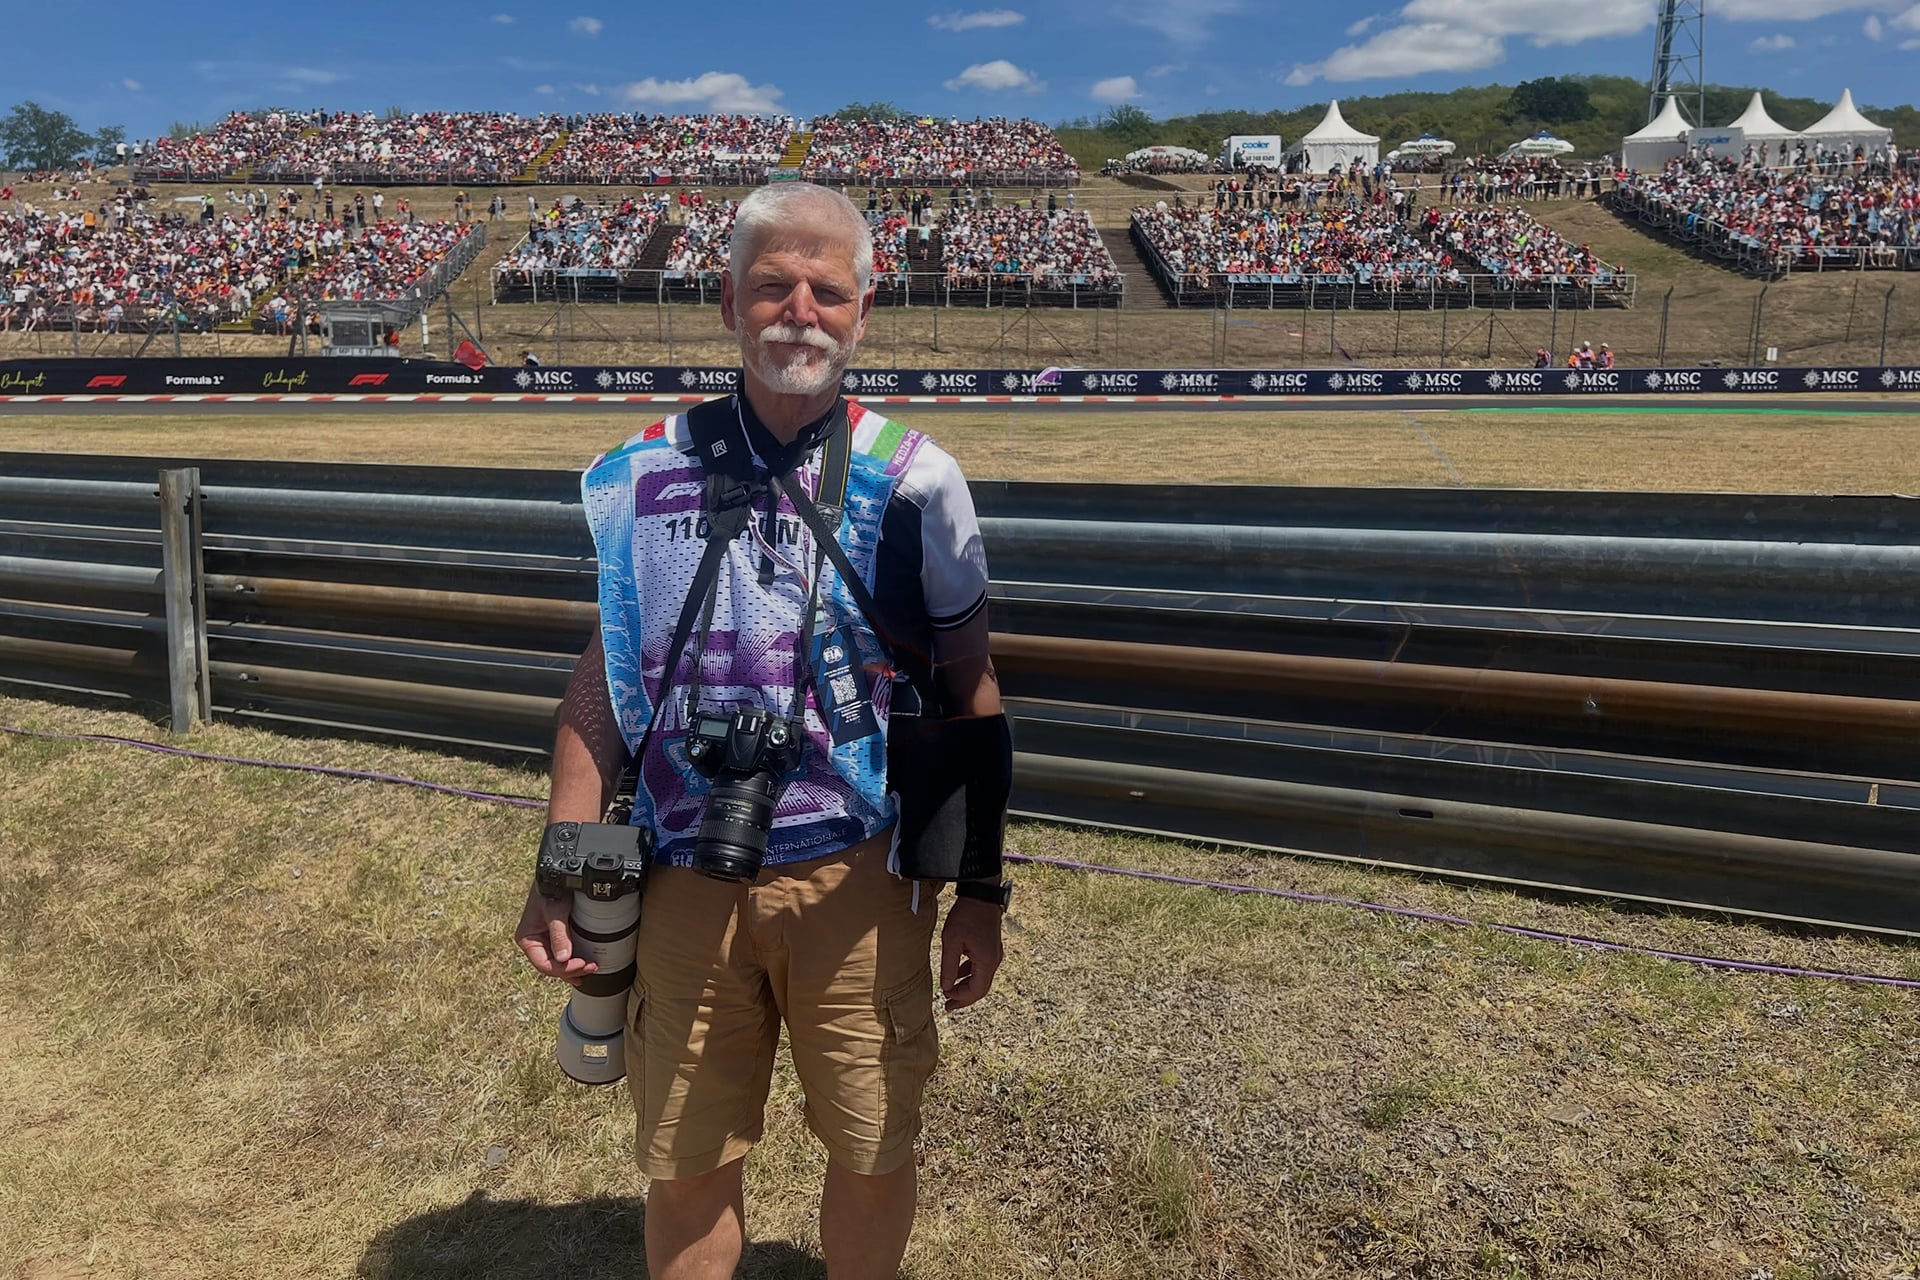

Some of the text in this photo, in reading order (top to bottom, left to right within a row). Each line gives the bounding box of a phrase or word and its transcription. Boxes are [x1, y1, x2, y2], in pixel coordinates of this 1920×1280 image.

[1242, 141, 1270, 149] cooler
[166, 375, 212, 385] Formula
[262, 369, 308, 391] Budapest
[426, 374, 472, 384] Formula
[534, 372, 572, 385] MSC
[616, 372, 653, 385] MSC
[700, 371, 736, 385] MSC
[862, 374, 898, 387] MSC
[940, 374, 976, 387] MSC
[1347, 374, 1382, 387] MSC
[1425, 373, 1461, 386] MSC
[1506, 373, 1542, 386] MSC
[1583, 373, 1618, 386] MSC
[1664, 372, 1701, 385] MSC
[1742, 371, 1778, 385] MSC
[1822, 371, 1858, 384] MSC
[1899, 371, 1920, 384] MS
[665, 516, 712, 542] 110
[822, 645, 844, 664] FIA
[765, 826, 847, 856] NTERNATIONALE
[761, 852, 786, 866] OBILE
